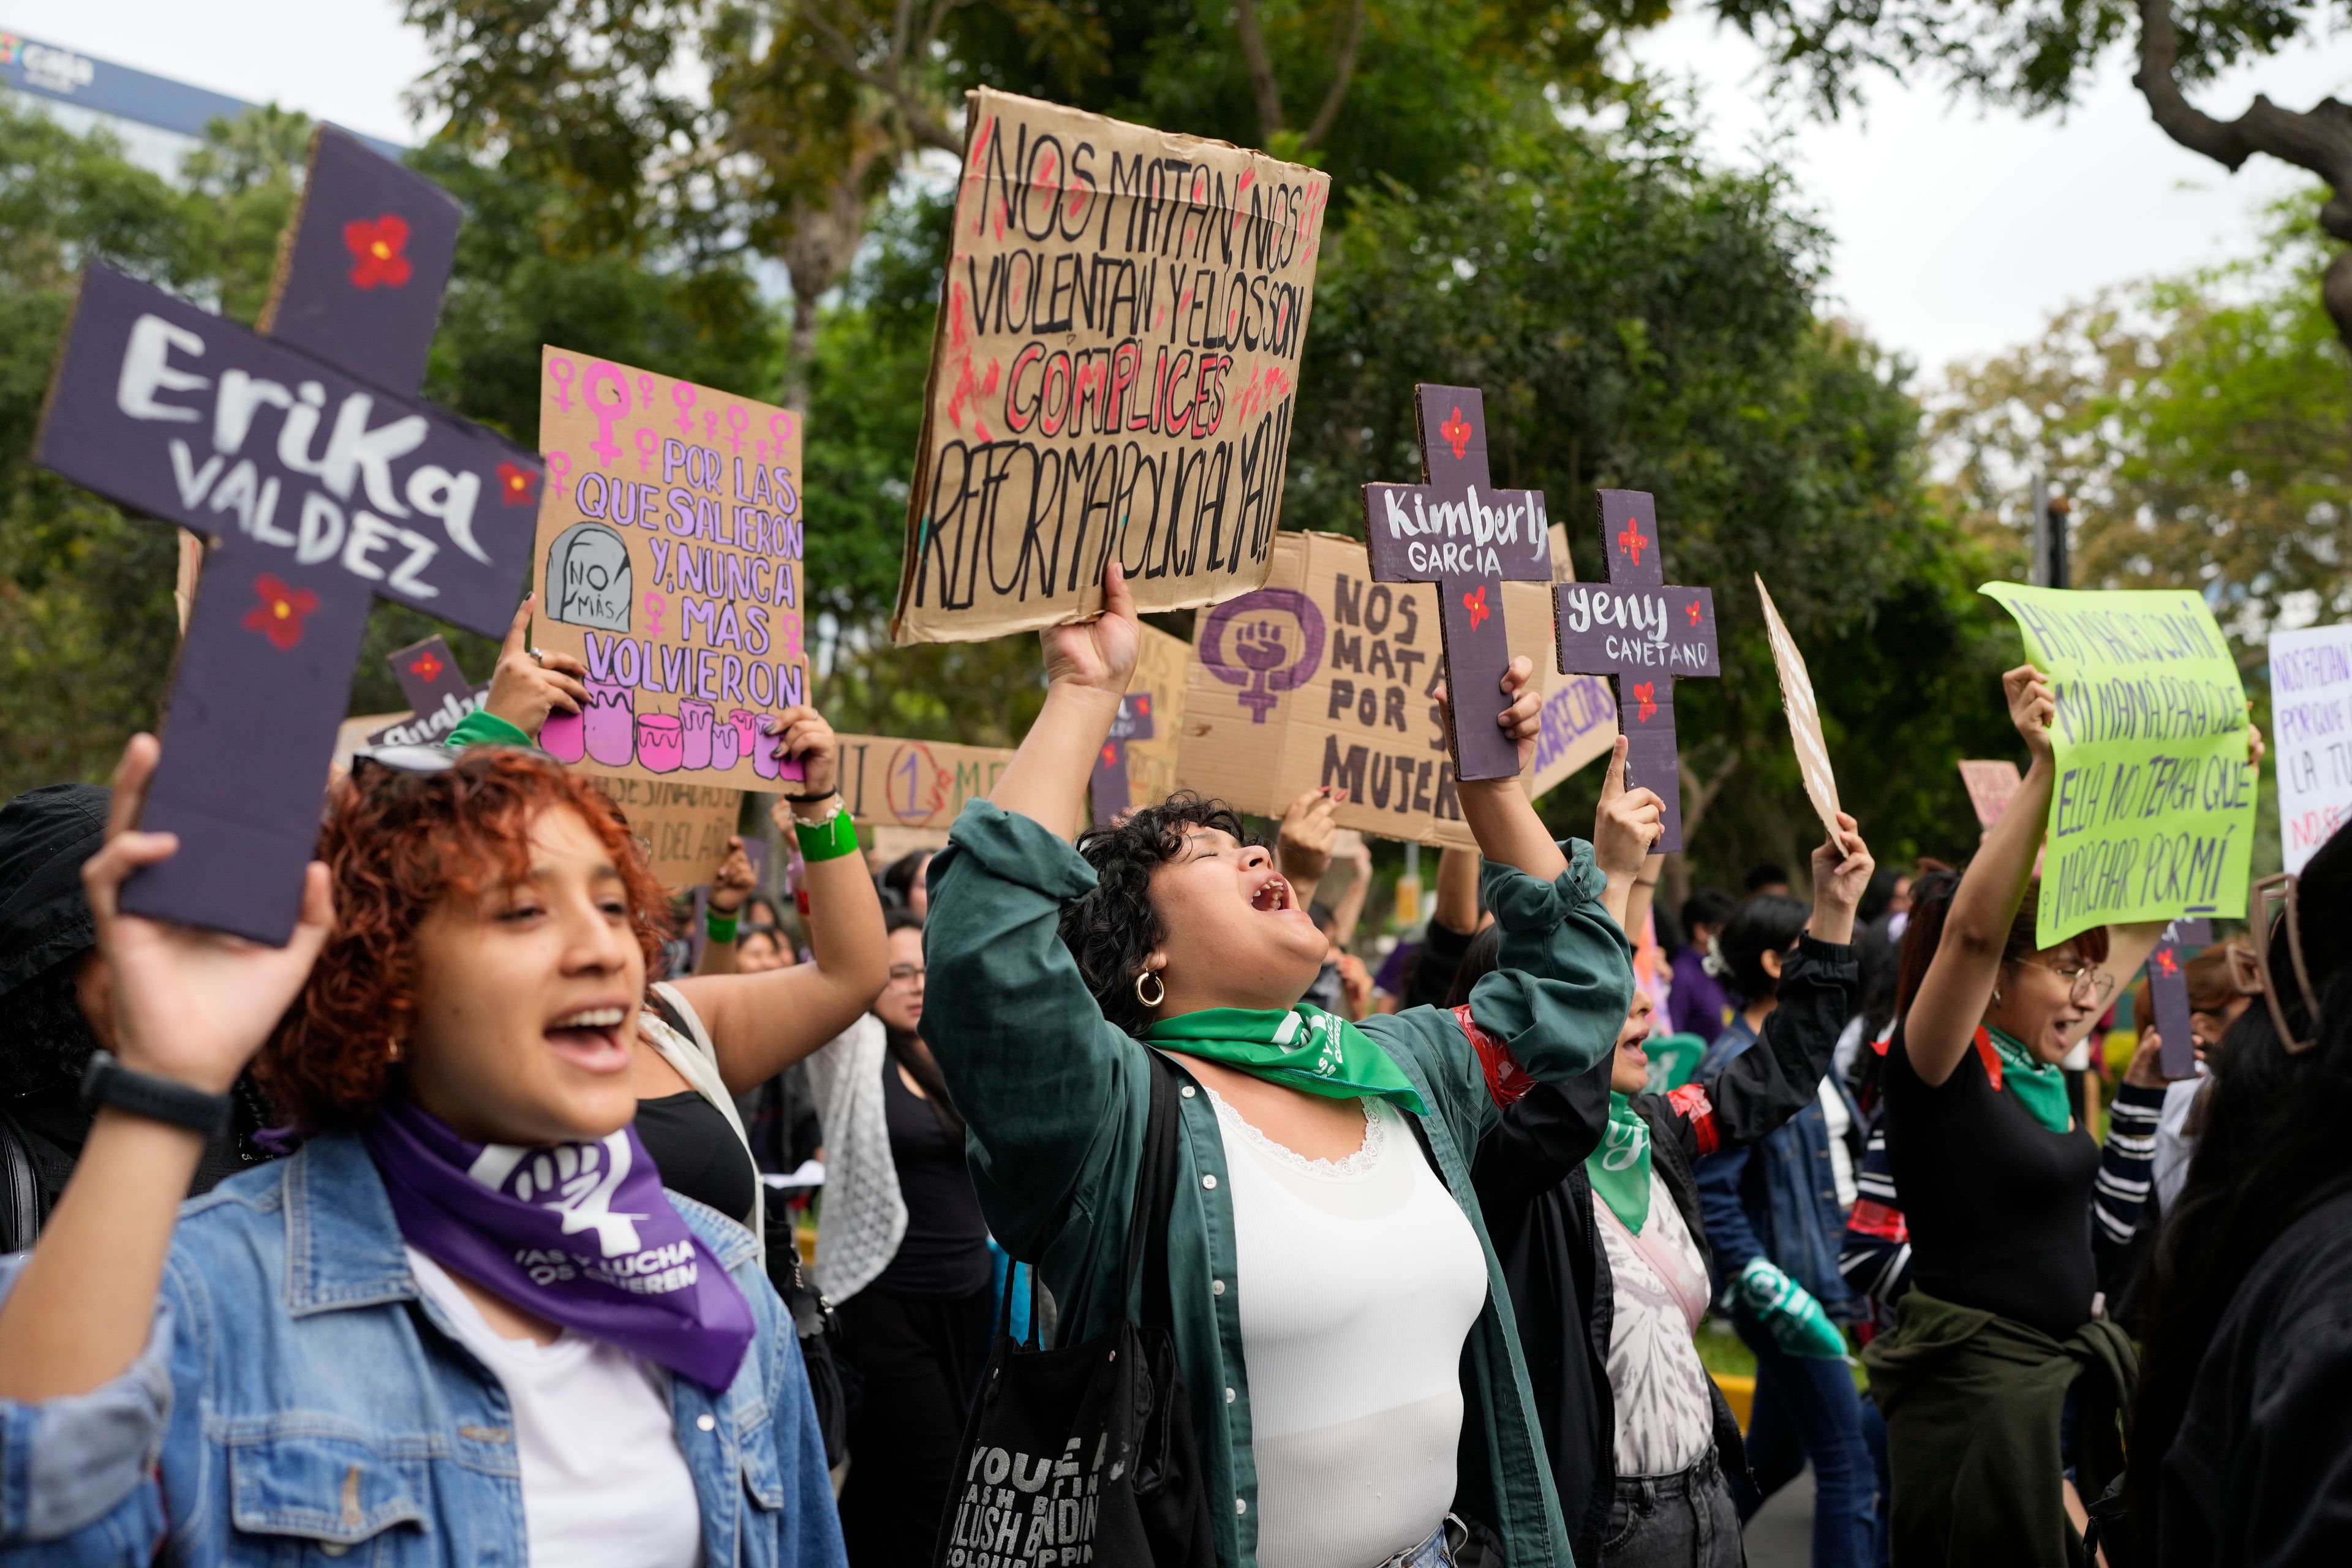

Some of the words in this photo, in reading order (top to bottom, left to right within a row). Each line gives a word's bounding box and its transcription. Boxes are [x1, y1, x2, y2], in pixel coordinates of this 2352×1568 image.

[980, 116, 1097, 242] NOS
[1241, 183, 1303, 274] NOS
[969, 249, 1157, 339] VIOLENTAN
[1170, 263, 1187, 344] Y
[1262, 281, 1305, 360] SON
[663, 439, 722, 495] POR
[734, 457, 796, 514] LAS
[168, 438, 441, 599] VALDEZ
[576, 472, 660, 530] QUE
[666, 488, 804, 561] SALIERON
[915, 440, 1118, 611] REFORMA
[1384, 484, 1548, 562] Kimberly
[570, 560, 609, 592] NO
[1408, 541, 1503, 578] GARCIA
[1335, 573, 1419, 645] NOS
[584, 631, 802, 709] VOLVIERON
[1605, 635, 1709, 669] CAYETANO
[1327, 679, 1407, 732] POR
[2057, 761, 2106, 838] ELLA
[2103, 763, 2141, 826] NO
[2204, 753, 2251, 812] QUE
[2054, 837, 2139, 930] MARCHAR
[2139, 832, 2190, 908] POR
[1322, 1041, 1333, 1056] Y
